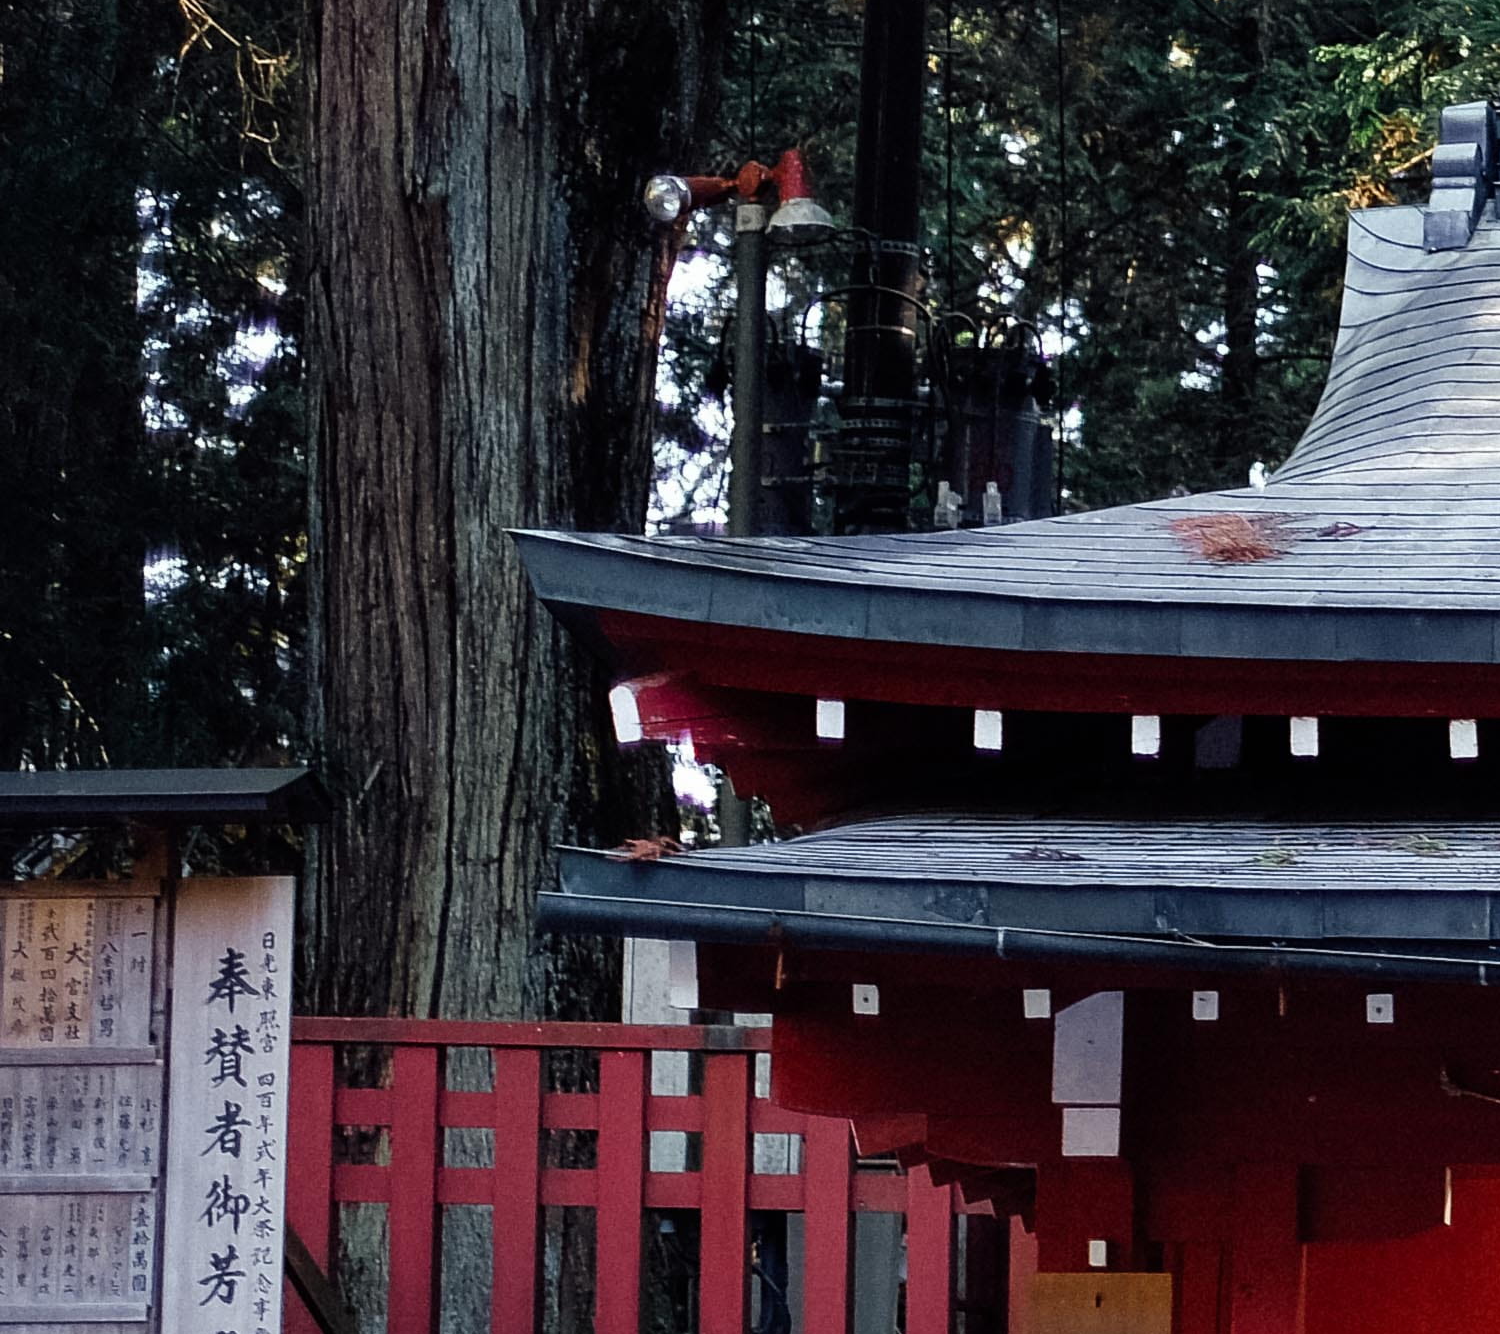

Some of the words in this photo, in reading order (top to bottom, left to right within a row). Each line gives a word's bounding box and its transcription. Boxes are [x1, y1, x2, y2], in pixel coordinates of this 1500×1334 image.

[256, 931, 280, 1054] 日光東照宮
